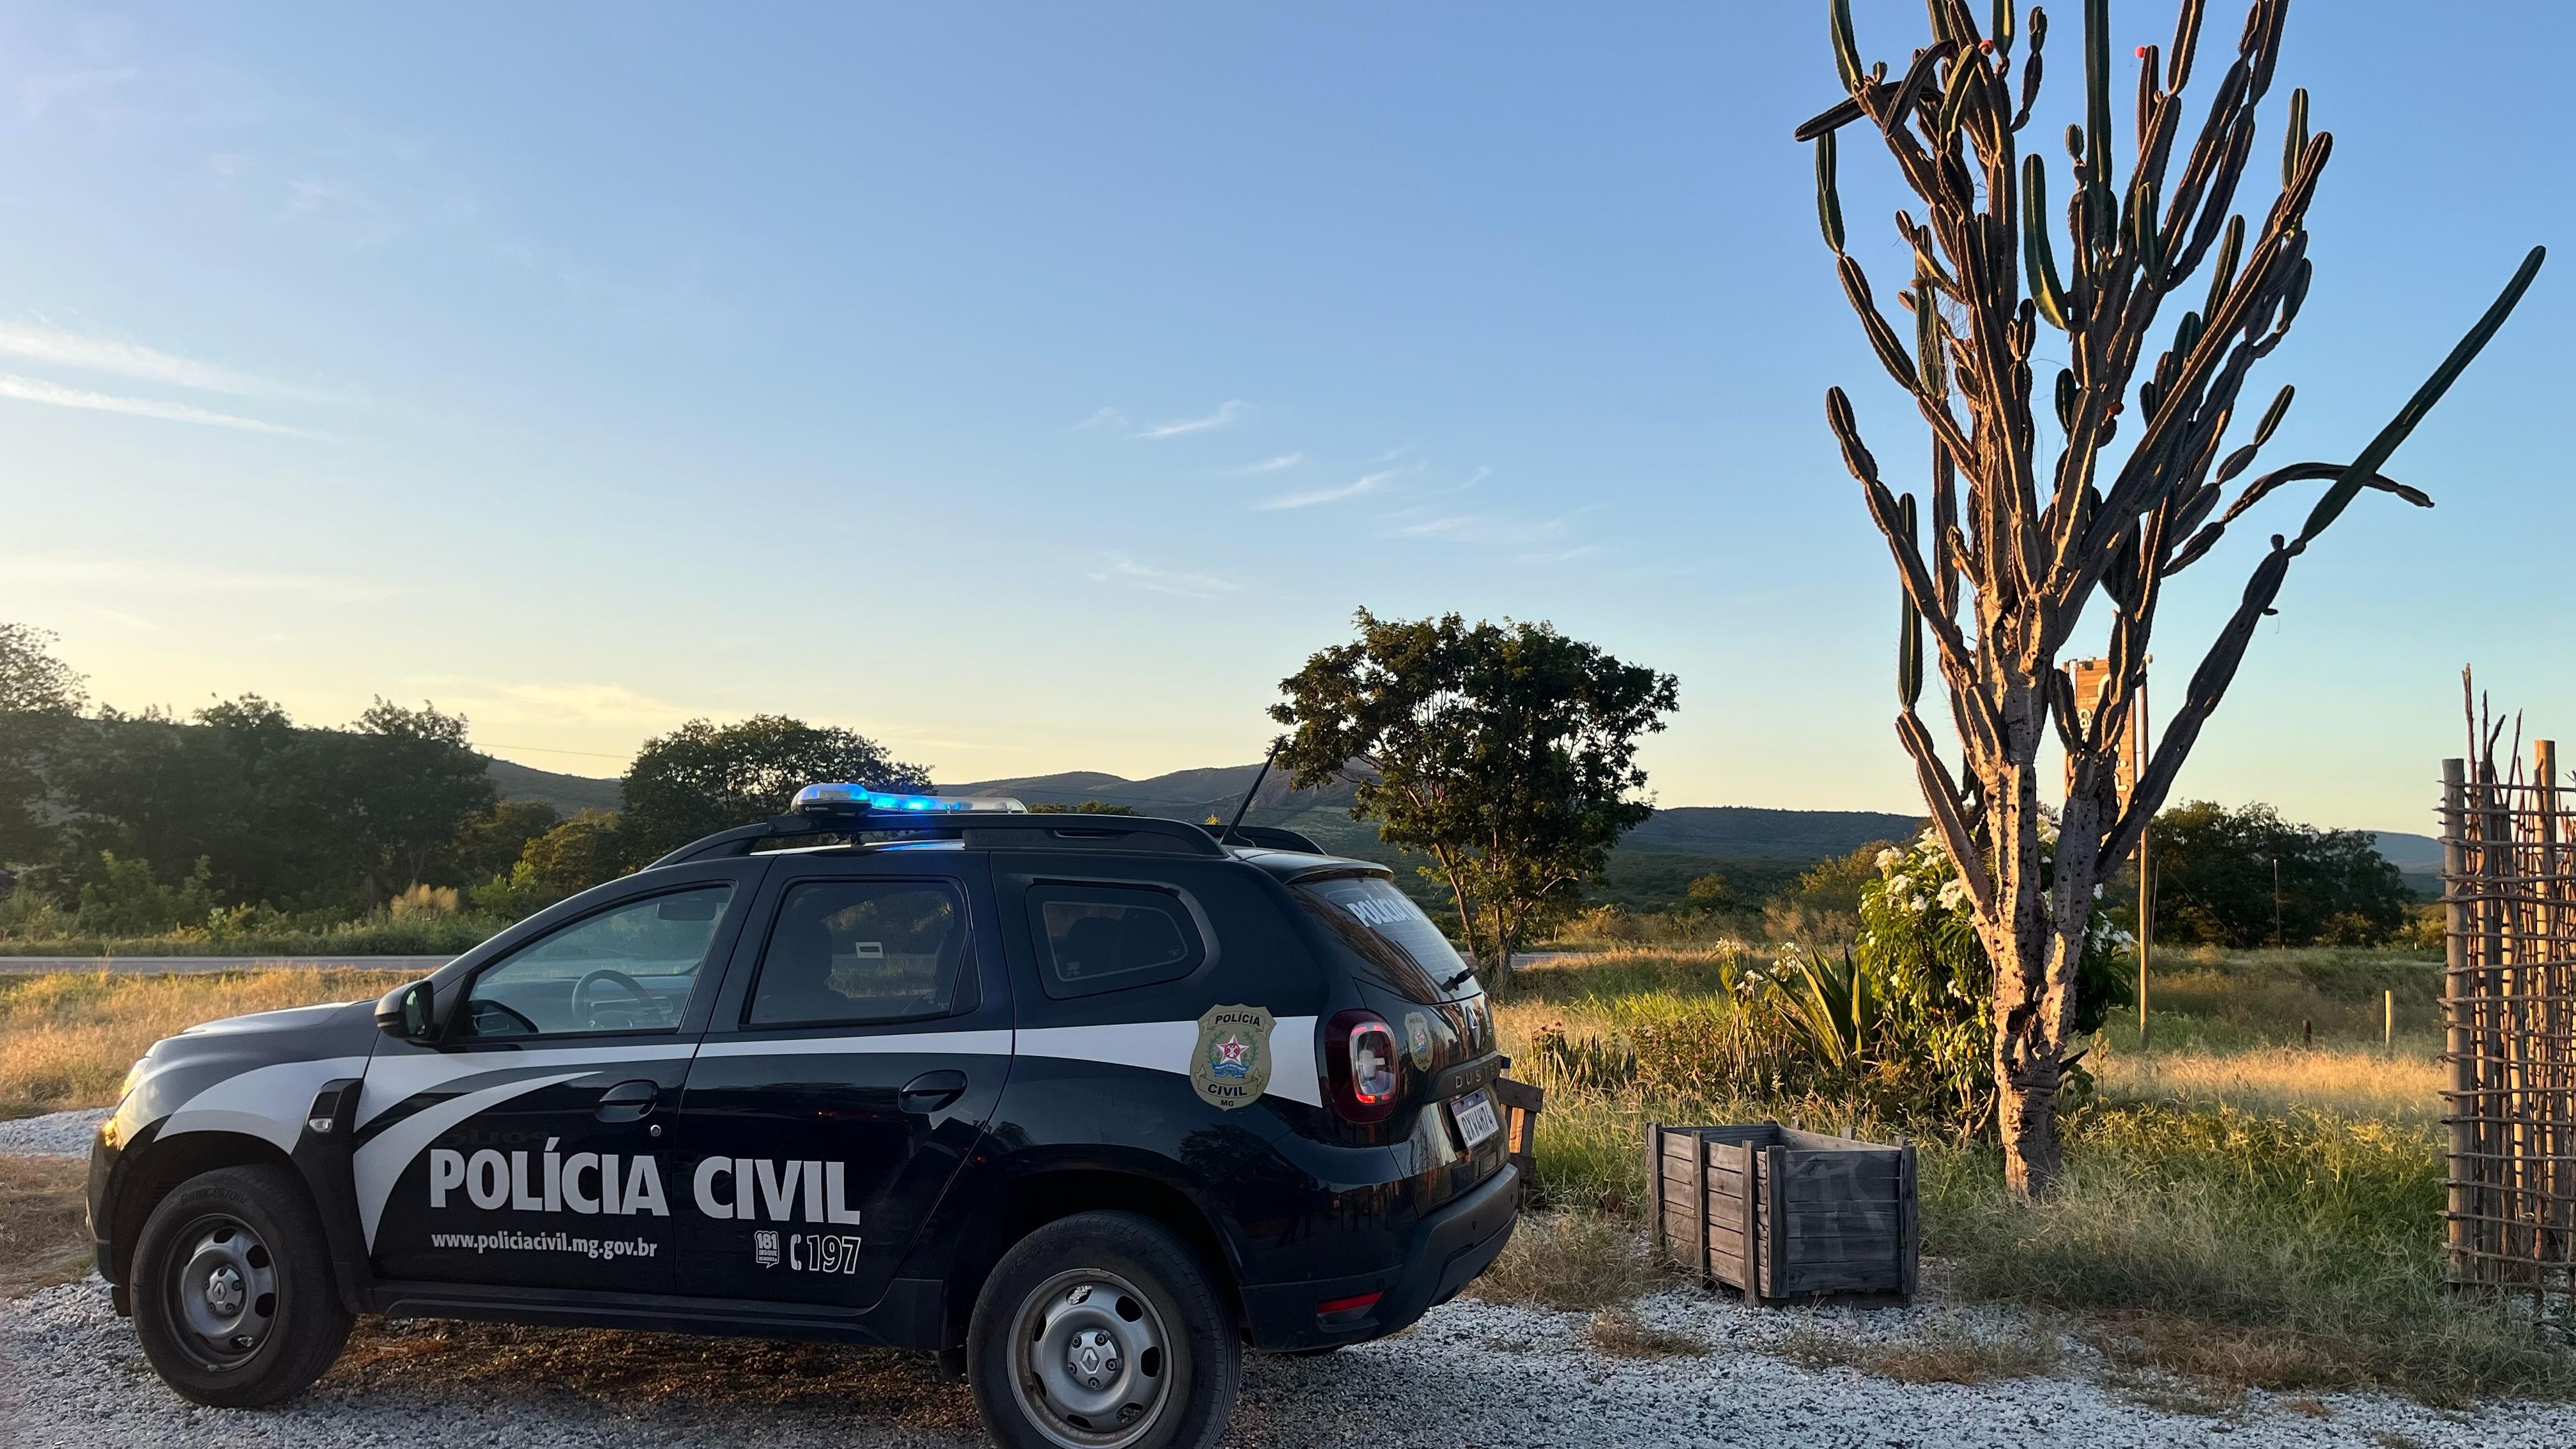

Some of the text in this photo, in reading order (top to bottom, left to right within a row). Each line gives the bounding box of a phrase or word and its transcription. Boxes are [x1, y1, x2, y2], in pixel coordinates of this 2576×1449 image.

[1215, 1011, 1260, 1027] POLÍCIA
[1208, 1084, 1247, 1096] CIVIL
[431, 1137, 861, 1225] POLÍCIA CIVIL
[431, 1230, 657, 1260] www.policiacivil.mg.gov.br
[756, 1233, 778, 1250] 181
[807, 1234, 861, 1275] 197
